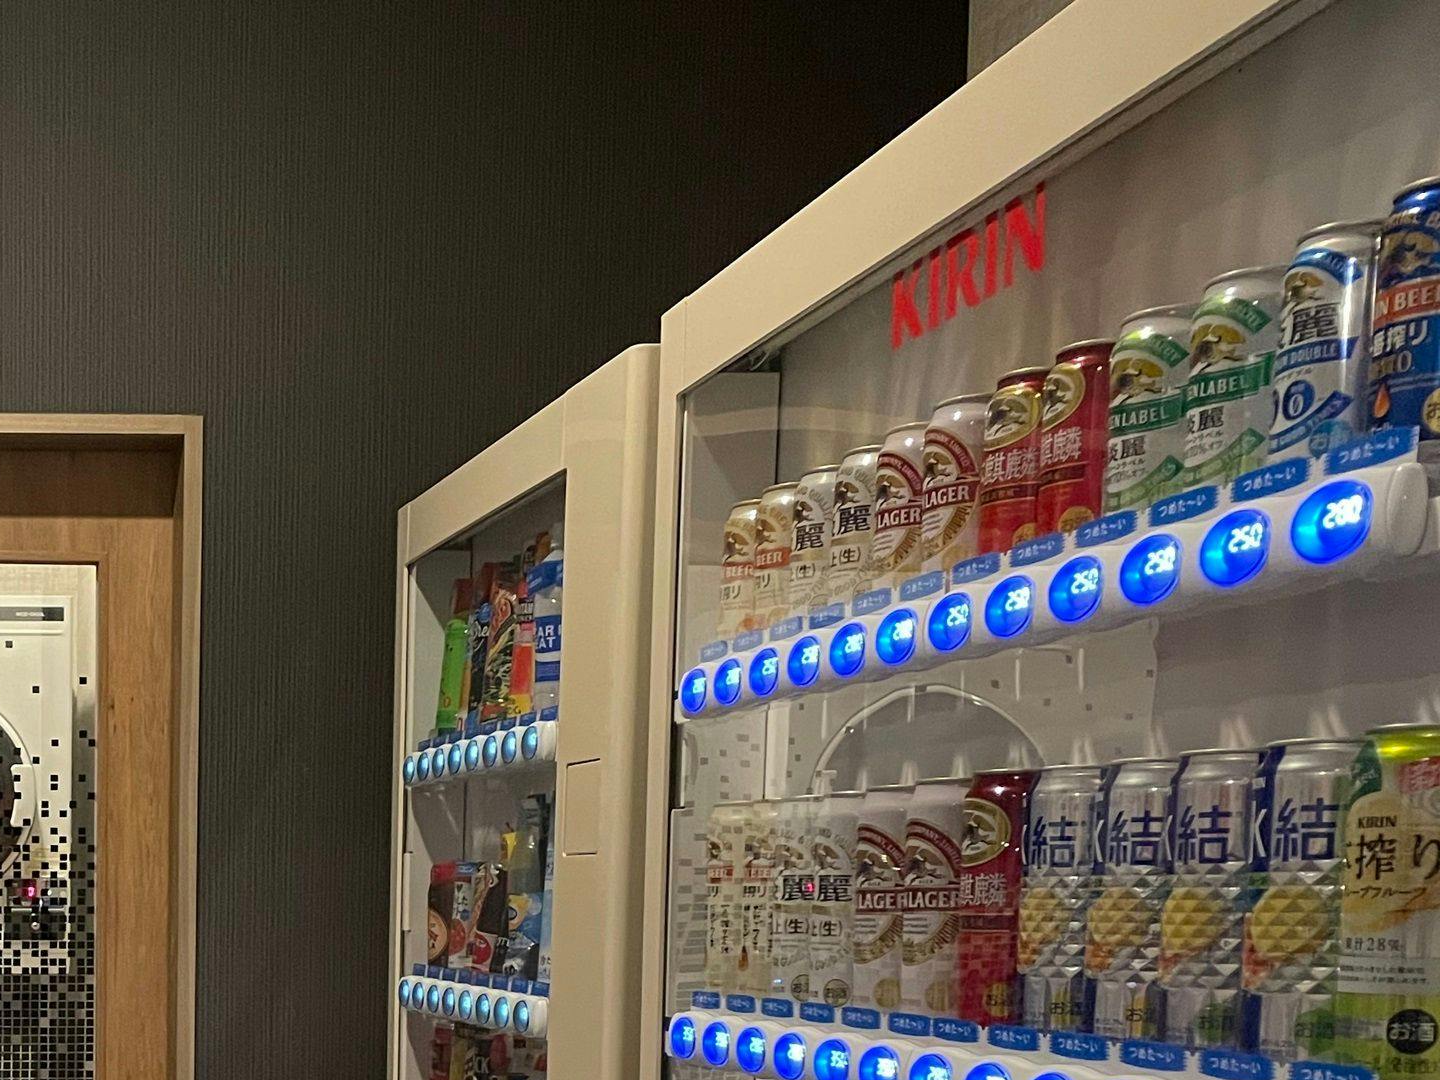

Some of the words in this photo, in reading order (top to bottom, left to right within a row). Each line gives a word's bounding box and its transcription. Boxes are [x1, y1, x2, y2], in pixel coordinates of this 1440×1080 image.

[891, 181, 1046, 351] KIRIN
[925, 486, 969, 507] LAGER
[878, 507, 922, 528] LAGER
[1228, 524, 1262, 552] 250
[1357, 815, 1397, 829] KIRIN
[1389, 1021, 1437, 1042] お酒
